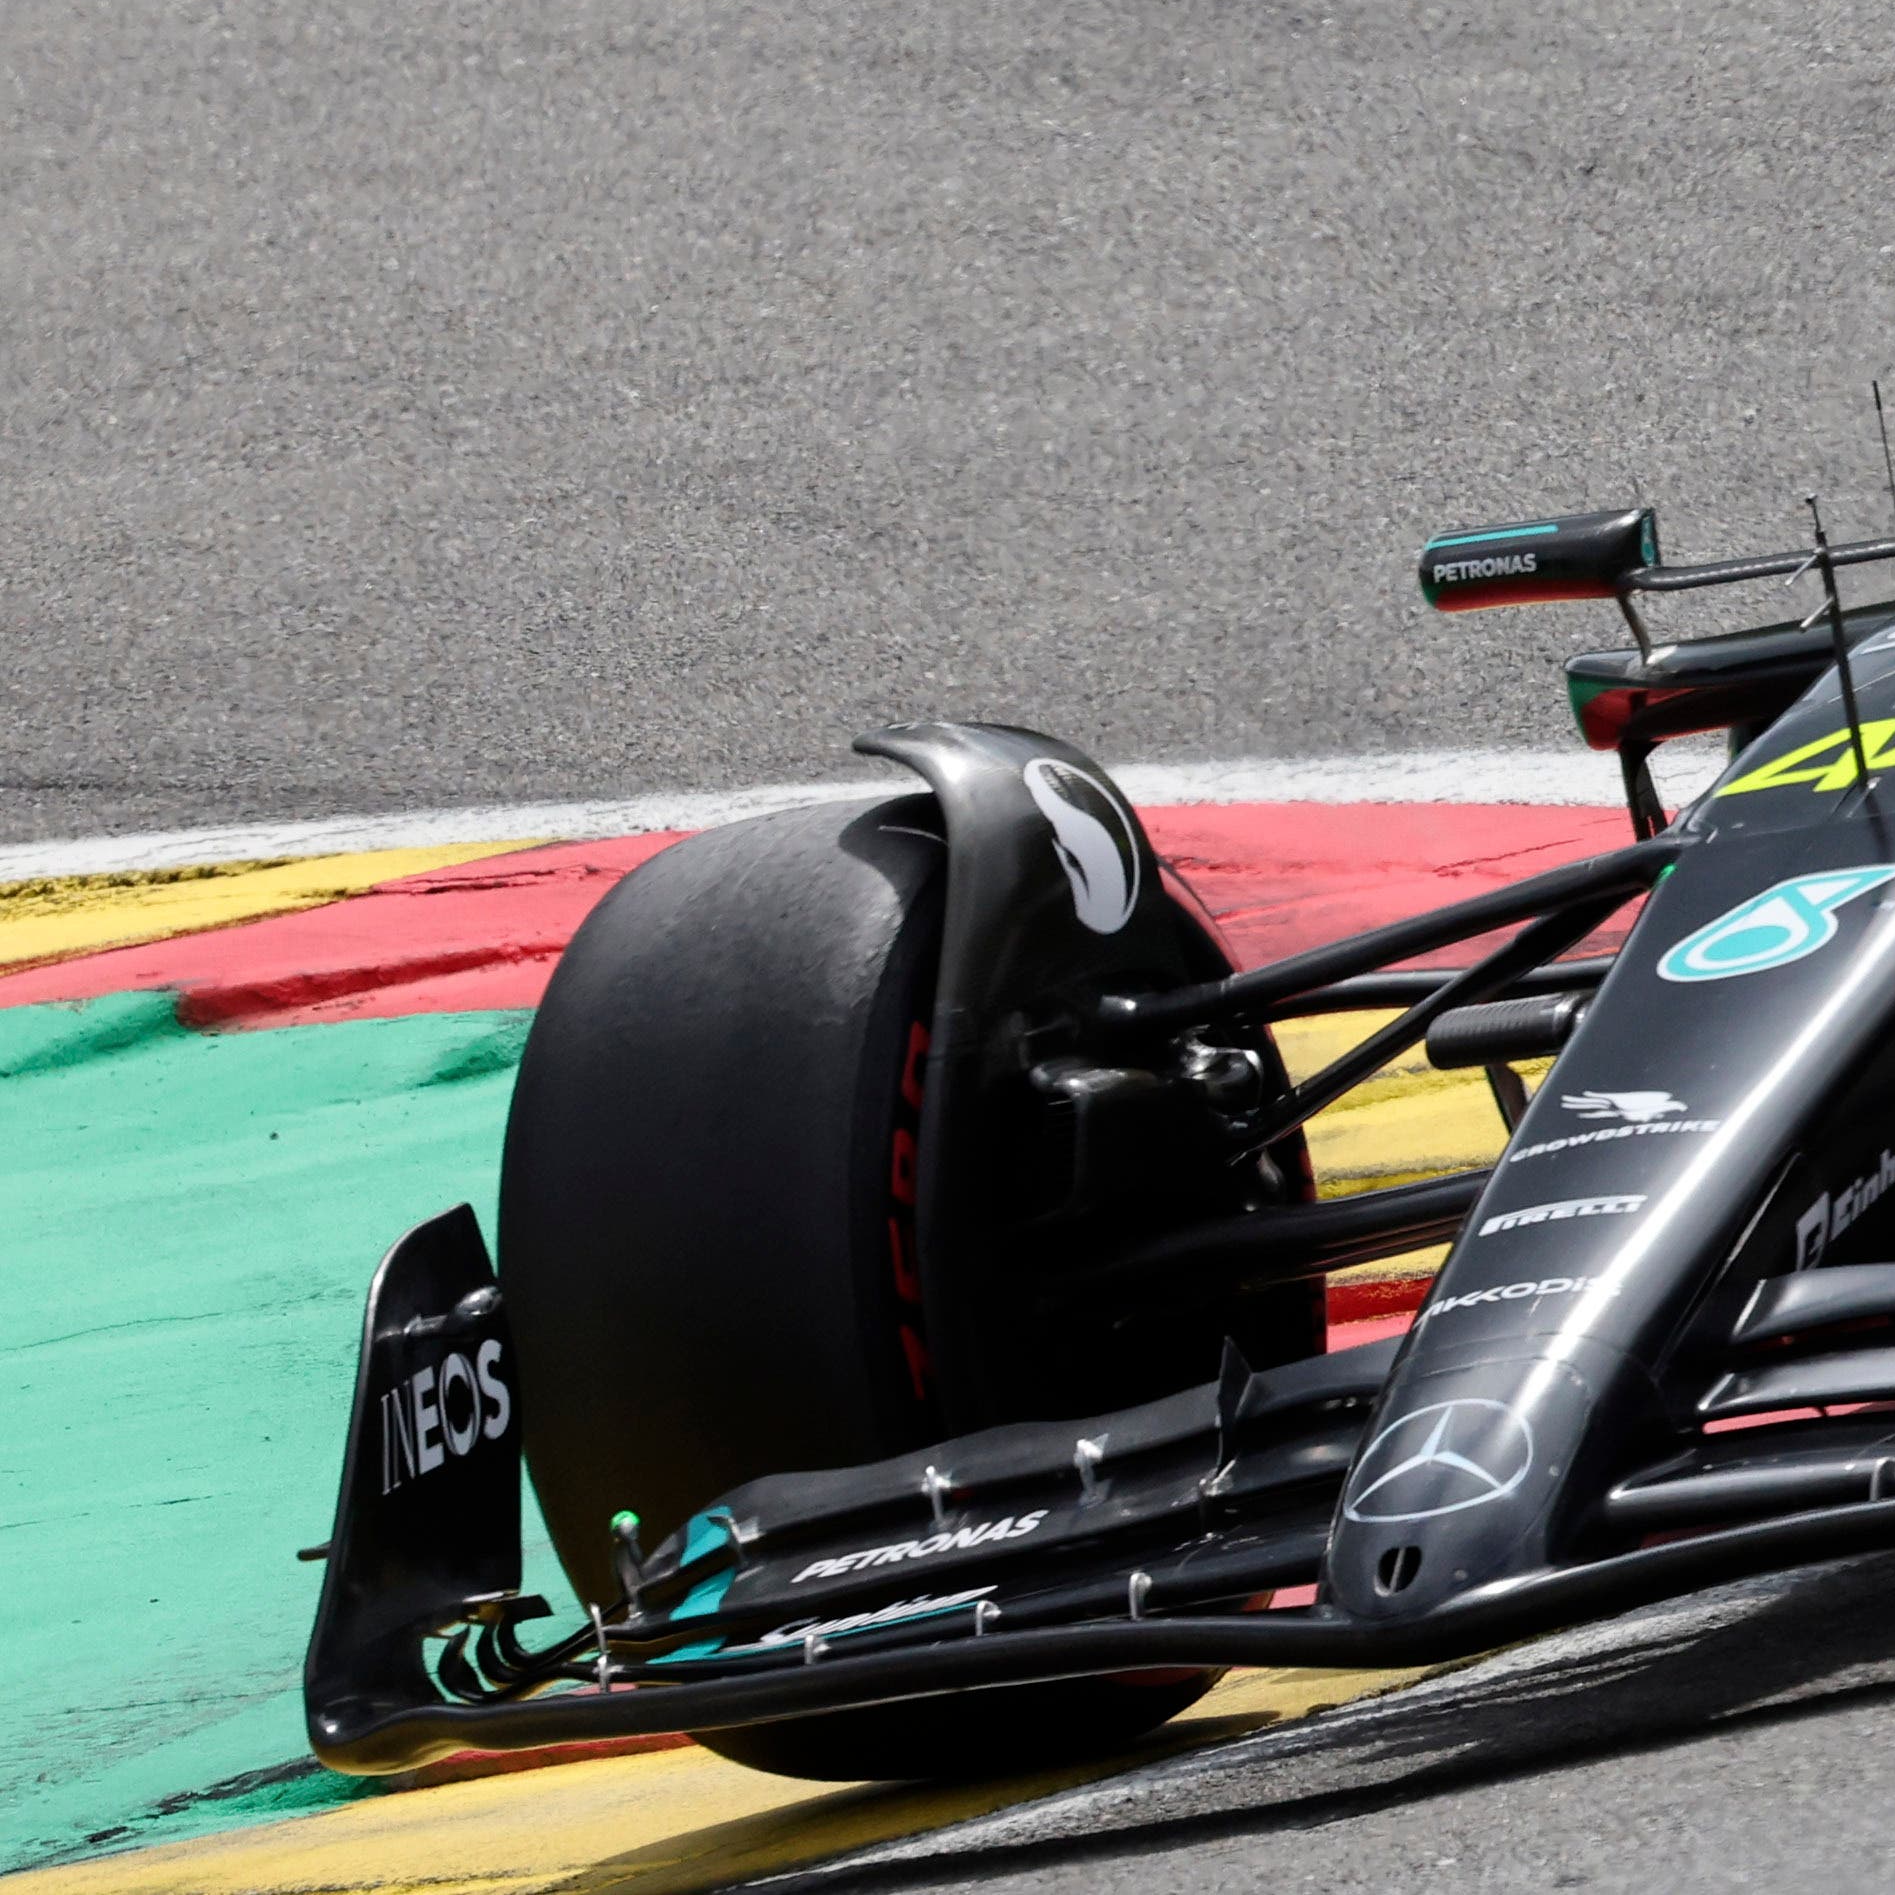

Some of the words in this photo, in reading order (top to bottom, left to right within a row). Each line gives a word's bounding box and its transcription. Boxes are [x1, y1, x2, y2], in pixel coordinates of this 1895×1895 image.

[1433, 553, 1538, 584] PETRONAS
[1509, 1120, 1722, 1163] CROWDSTRIKE
[1478, 1194, 1648, 1237] PIRELLI
[380, 1338, 511, 1496] INEOS
[789, 1509, 1050, 1584] PETRONAS
